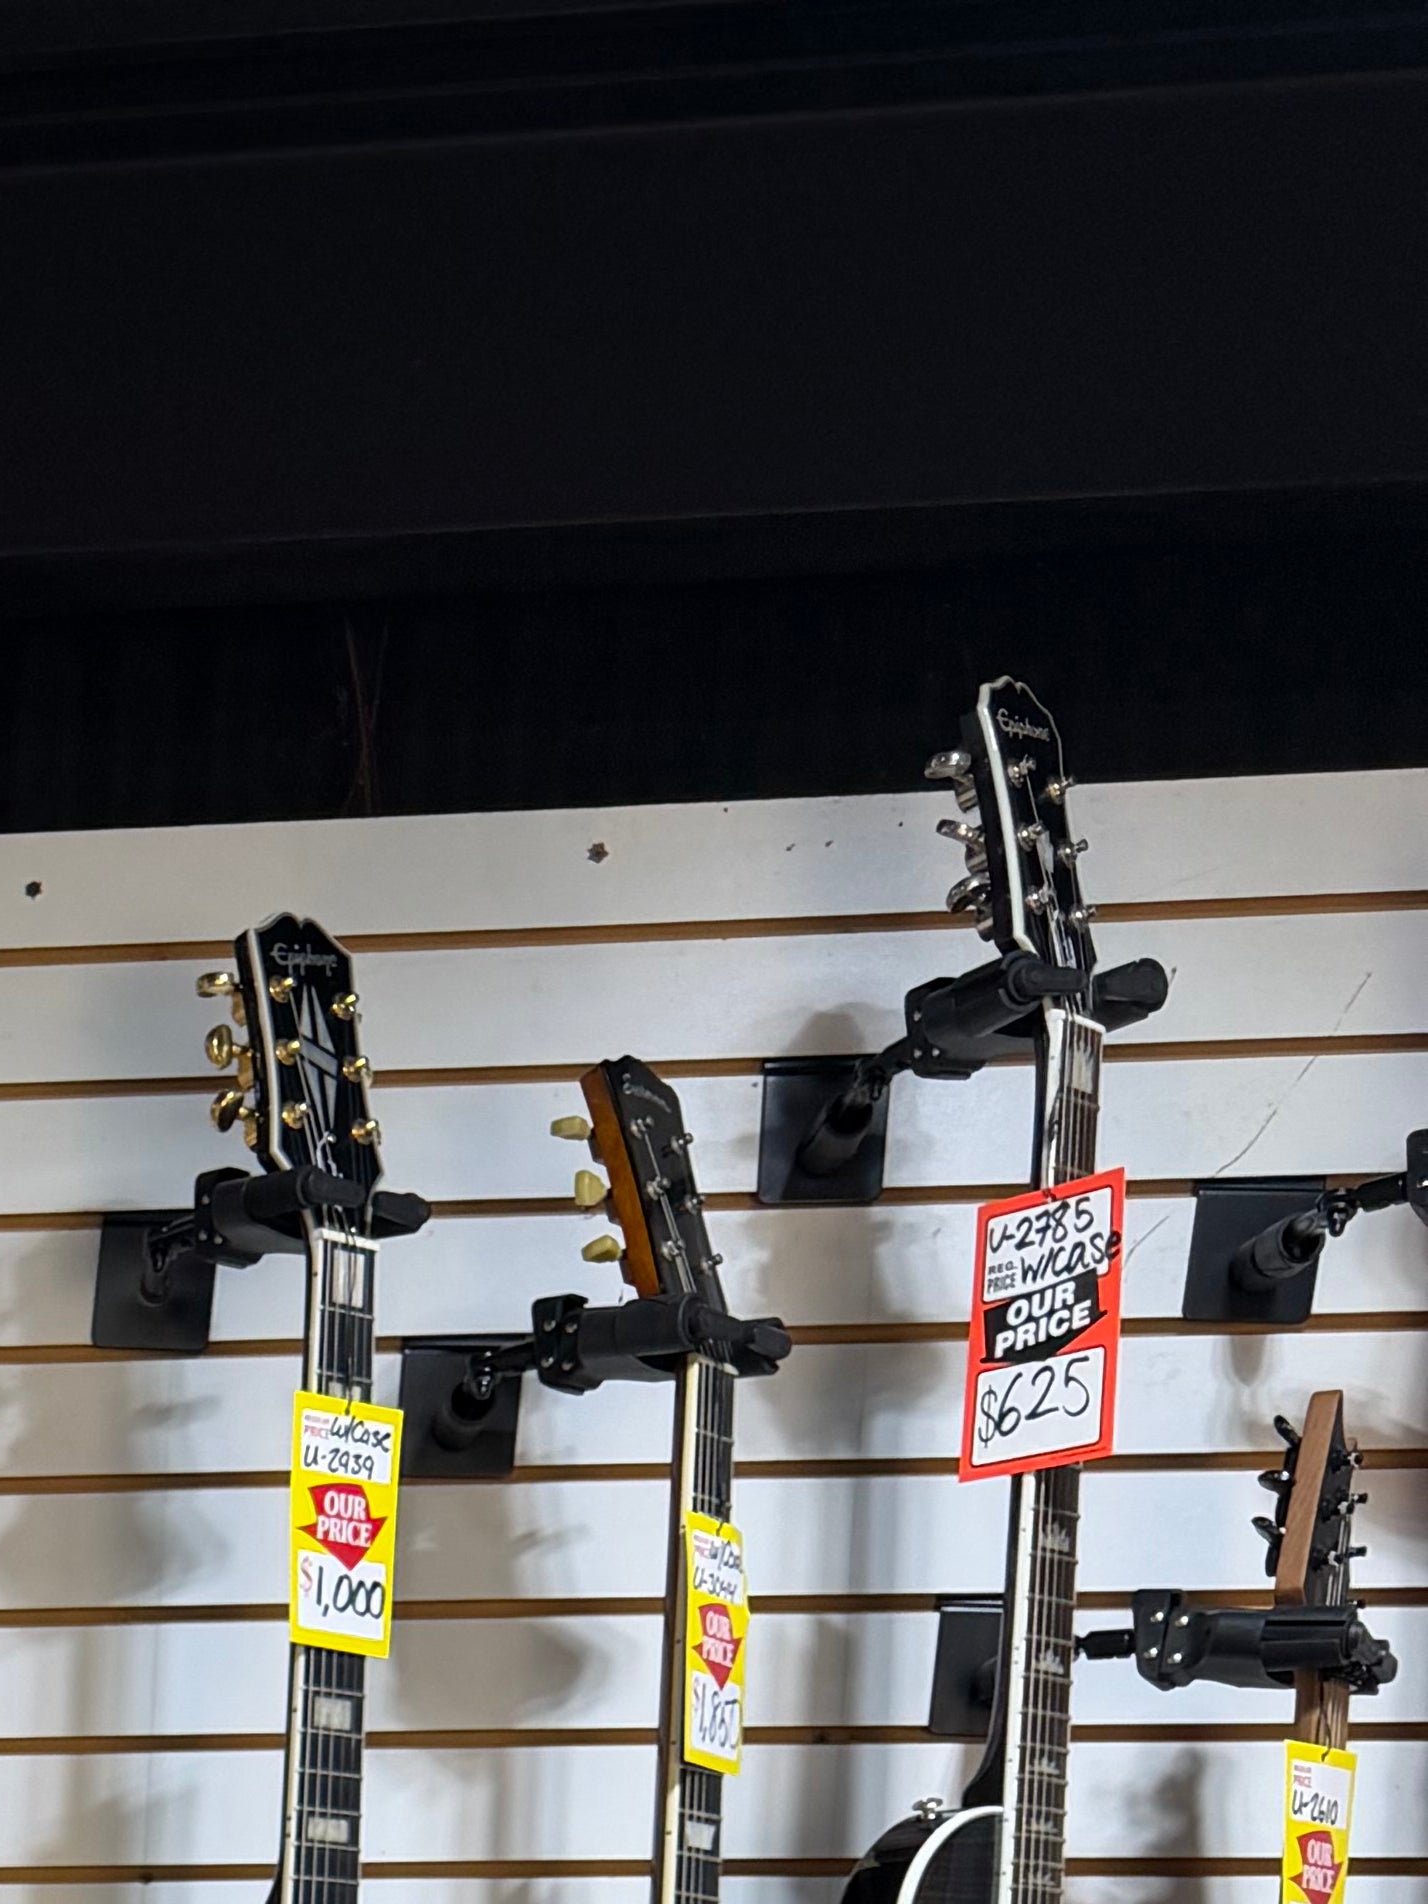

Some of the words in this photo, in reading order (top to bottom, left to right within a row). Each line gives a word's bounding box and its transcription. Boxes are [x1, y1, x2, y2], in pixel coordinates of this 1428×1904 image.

[269, 942, 338, 976] Epiphone
[1005, 1281, 1076, 1327] OUR
[994, 1300, 1092, 1360] PRICE
[978, 1355, 1091, 1449] $625
[304, 1444, 375, 1481] U-2939
[323, 1490, 368, 1522] OUR
[315, 1514, 373, 1549] PRICE
[300, 1556, 386, 1620] $1,000
[705, 1610, 731, 1641] OUR
[701, 1634, 735, 1667] PRICE
[1306, 1838, 1334, 1868] OUR
[1302, 1864, 1335, 1894] PRICE
